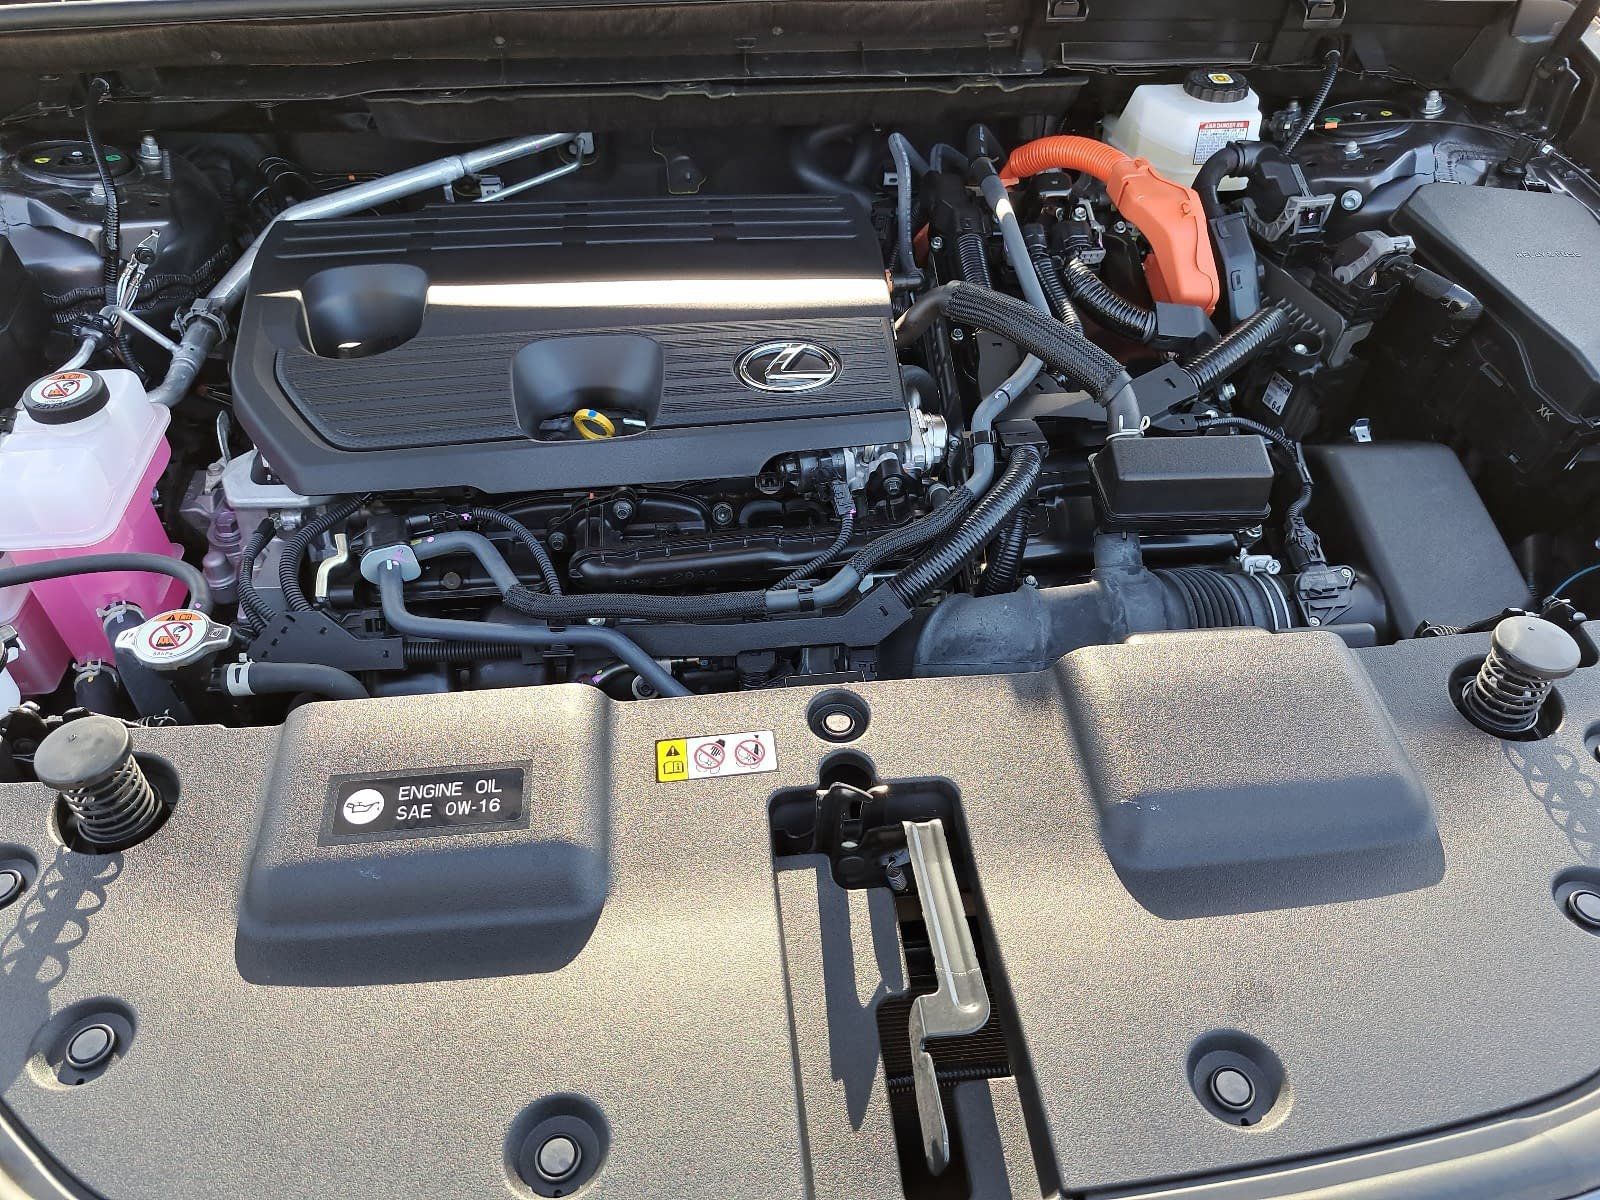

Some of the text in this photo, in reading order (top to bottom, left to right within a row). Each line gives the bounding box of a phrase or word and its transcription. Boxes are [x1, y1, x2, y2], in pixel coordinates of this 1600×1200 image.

[398, 778, 502, 801] ENGINE OIL
[395, 798, 501, 820] SAE 0W-16
